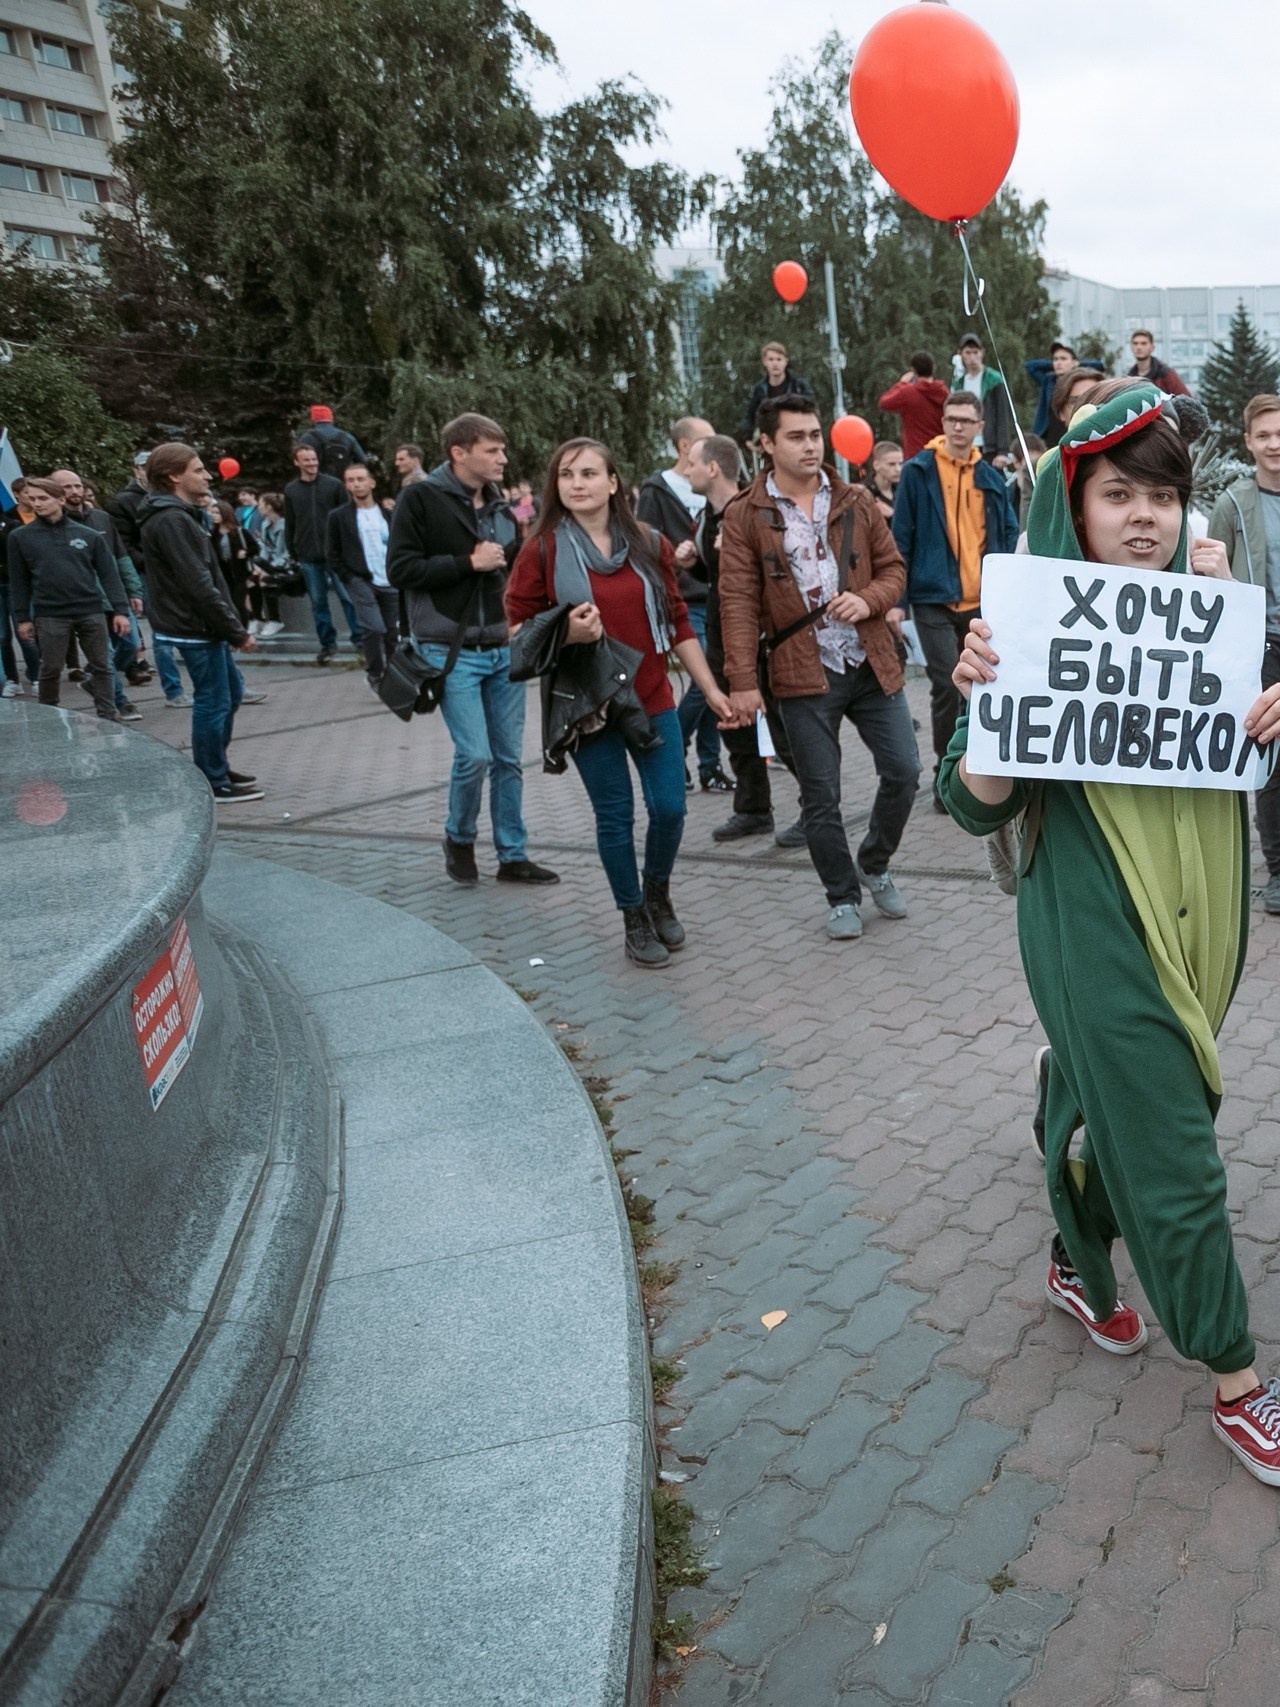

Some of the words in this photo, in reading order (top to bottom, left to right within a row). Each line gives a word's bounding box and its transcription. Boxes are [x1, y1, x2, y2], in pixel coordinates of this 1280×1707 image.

[1059, 576, 1225, 644] ХОЧУ
[1048, 638, 1222, 706] БЫТЬ
[135, 969, 174, 1033] ОСТОРОЖНО
[143, 1000, 181, 1069] СКОЛЬЗКО!
